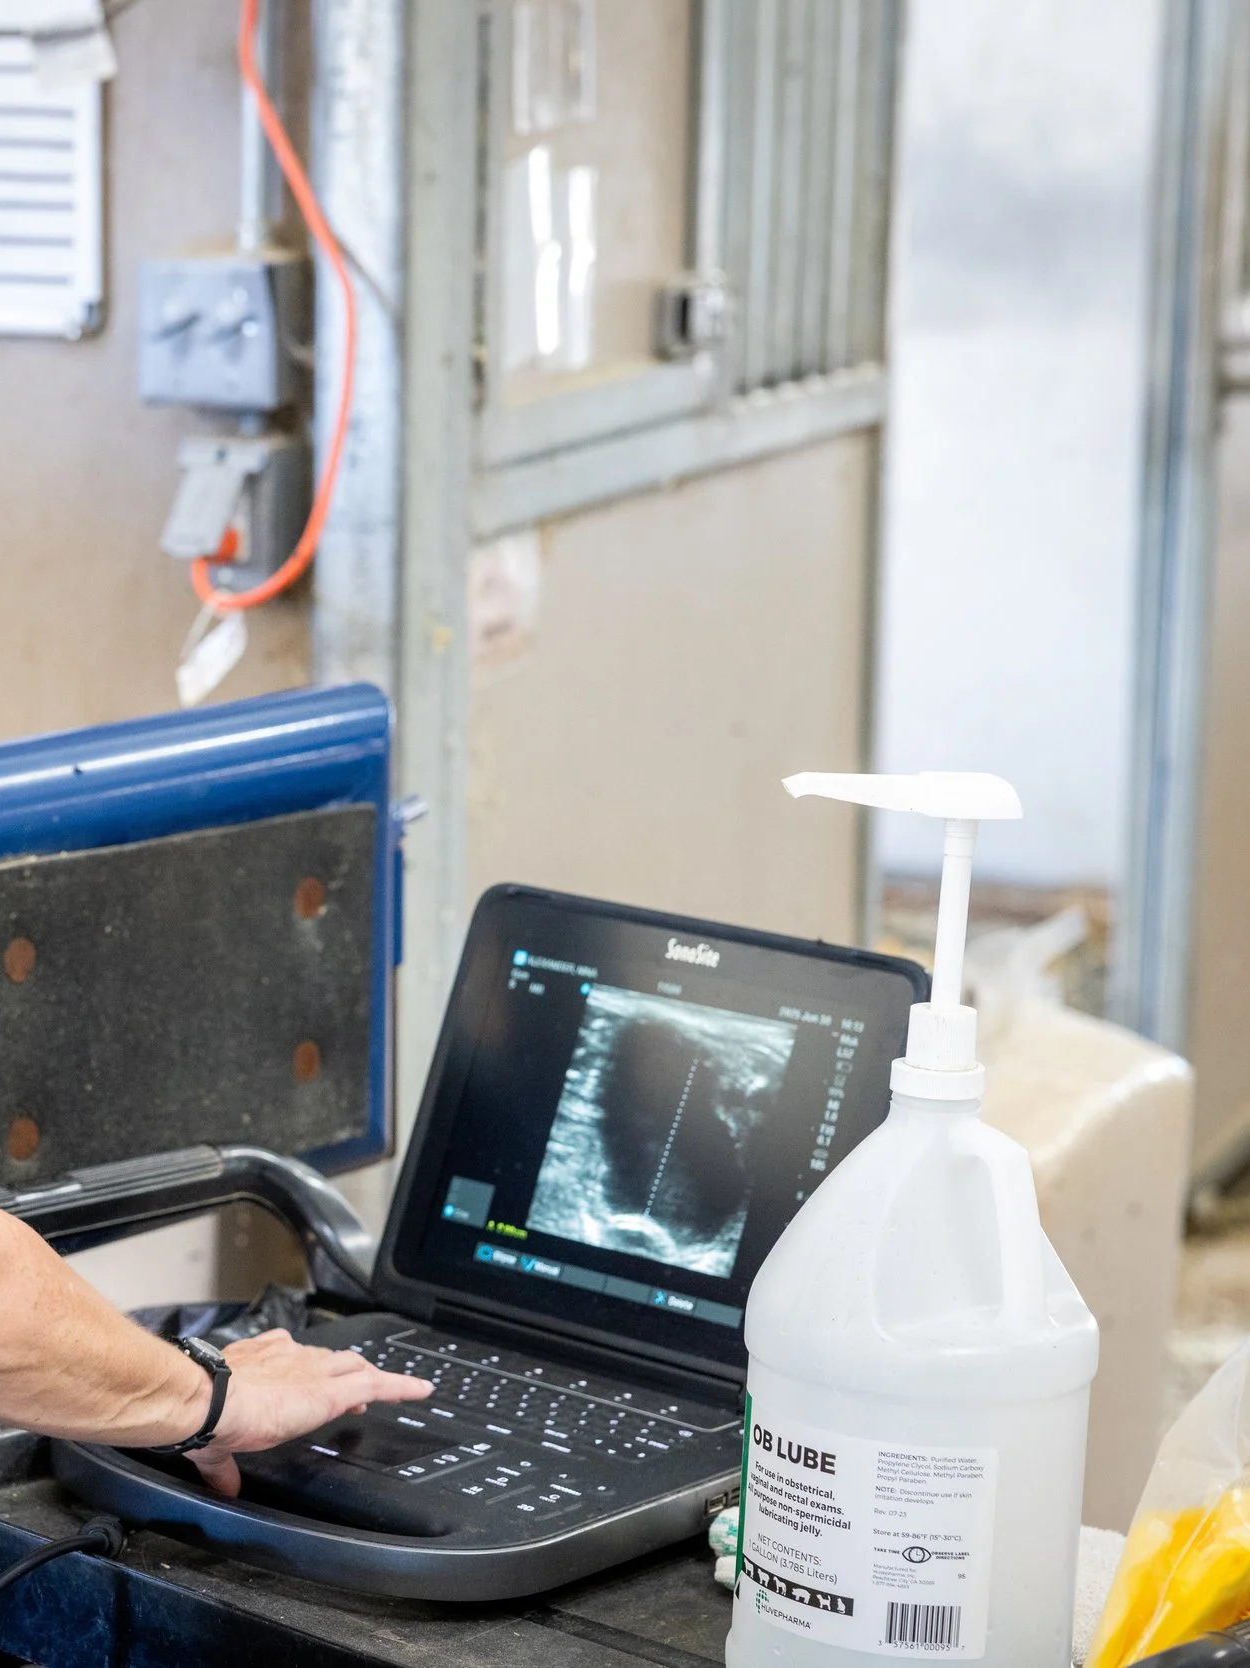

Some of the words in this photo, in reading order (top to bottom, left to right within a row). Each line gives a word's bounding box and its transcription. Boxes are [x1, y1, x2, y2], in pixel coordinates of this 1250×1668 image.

[664, 937, 721, 968] SonoSite
[753, 1423, 773, 1452] OB
[776, 1437, 837, 1476] LUBE
[878, 1451, 928, 1461] INGREDIENTS:
[931, 1456, 956, 1464] Purified
[877, 1458, 909, 1468] Propylene
[933, 1463, 958, 1471] Sodium
[877, 1466, 900, 1475] Methyl
[933, 1471, 956, 1480] Methyl
[754, 1460, 764, 1473] For
[764, 1469, 776, 1480] use
[776, 1472, 784, 1483] in
[785, 1477, 835, 1501] obstetrical,
[875, 1485, 897, 1494] NOTE:
[900, 1488, 939, 1497] Discontinue
[877, 1474, 897, 1483] Propyl
[749, 1471, 769, 1490] vaginal
[769, 1483, 783, 1496] and
[784, 1490, 808, 1506] rectal
[810, 1499, 844, 1515] exams.
[874, 1493, 903, 1502] irritation
[753, 1487, 777, 1507] purpose
[778, 1500, 851, 1530] non-spermicidal
[758, 1503, 799, 1531] lubricating
[799, 1521, 823, 1537] jelly.
[872, 1528, 891, 1537] Store
[757, 1532, 771, 1546] NET
[771, 1540, 822, 1566] CONTENTS:
[752, 1542, 779, 1564] GALLON
[779, 1557, 805, 1574] (3.785
[807, 1567, 838, 1585] Liters)
[761, 1602, 811, 1629] HUVEPHARMA
[893, 1640, 919, 1650] 57561
[924, 1644, 951, 1652] 00095
